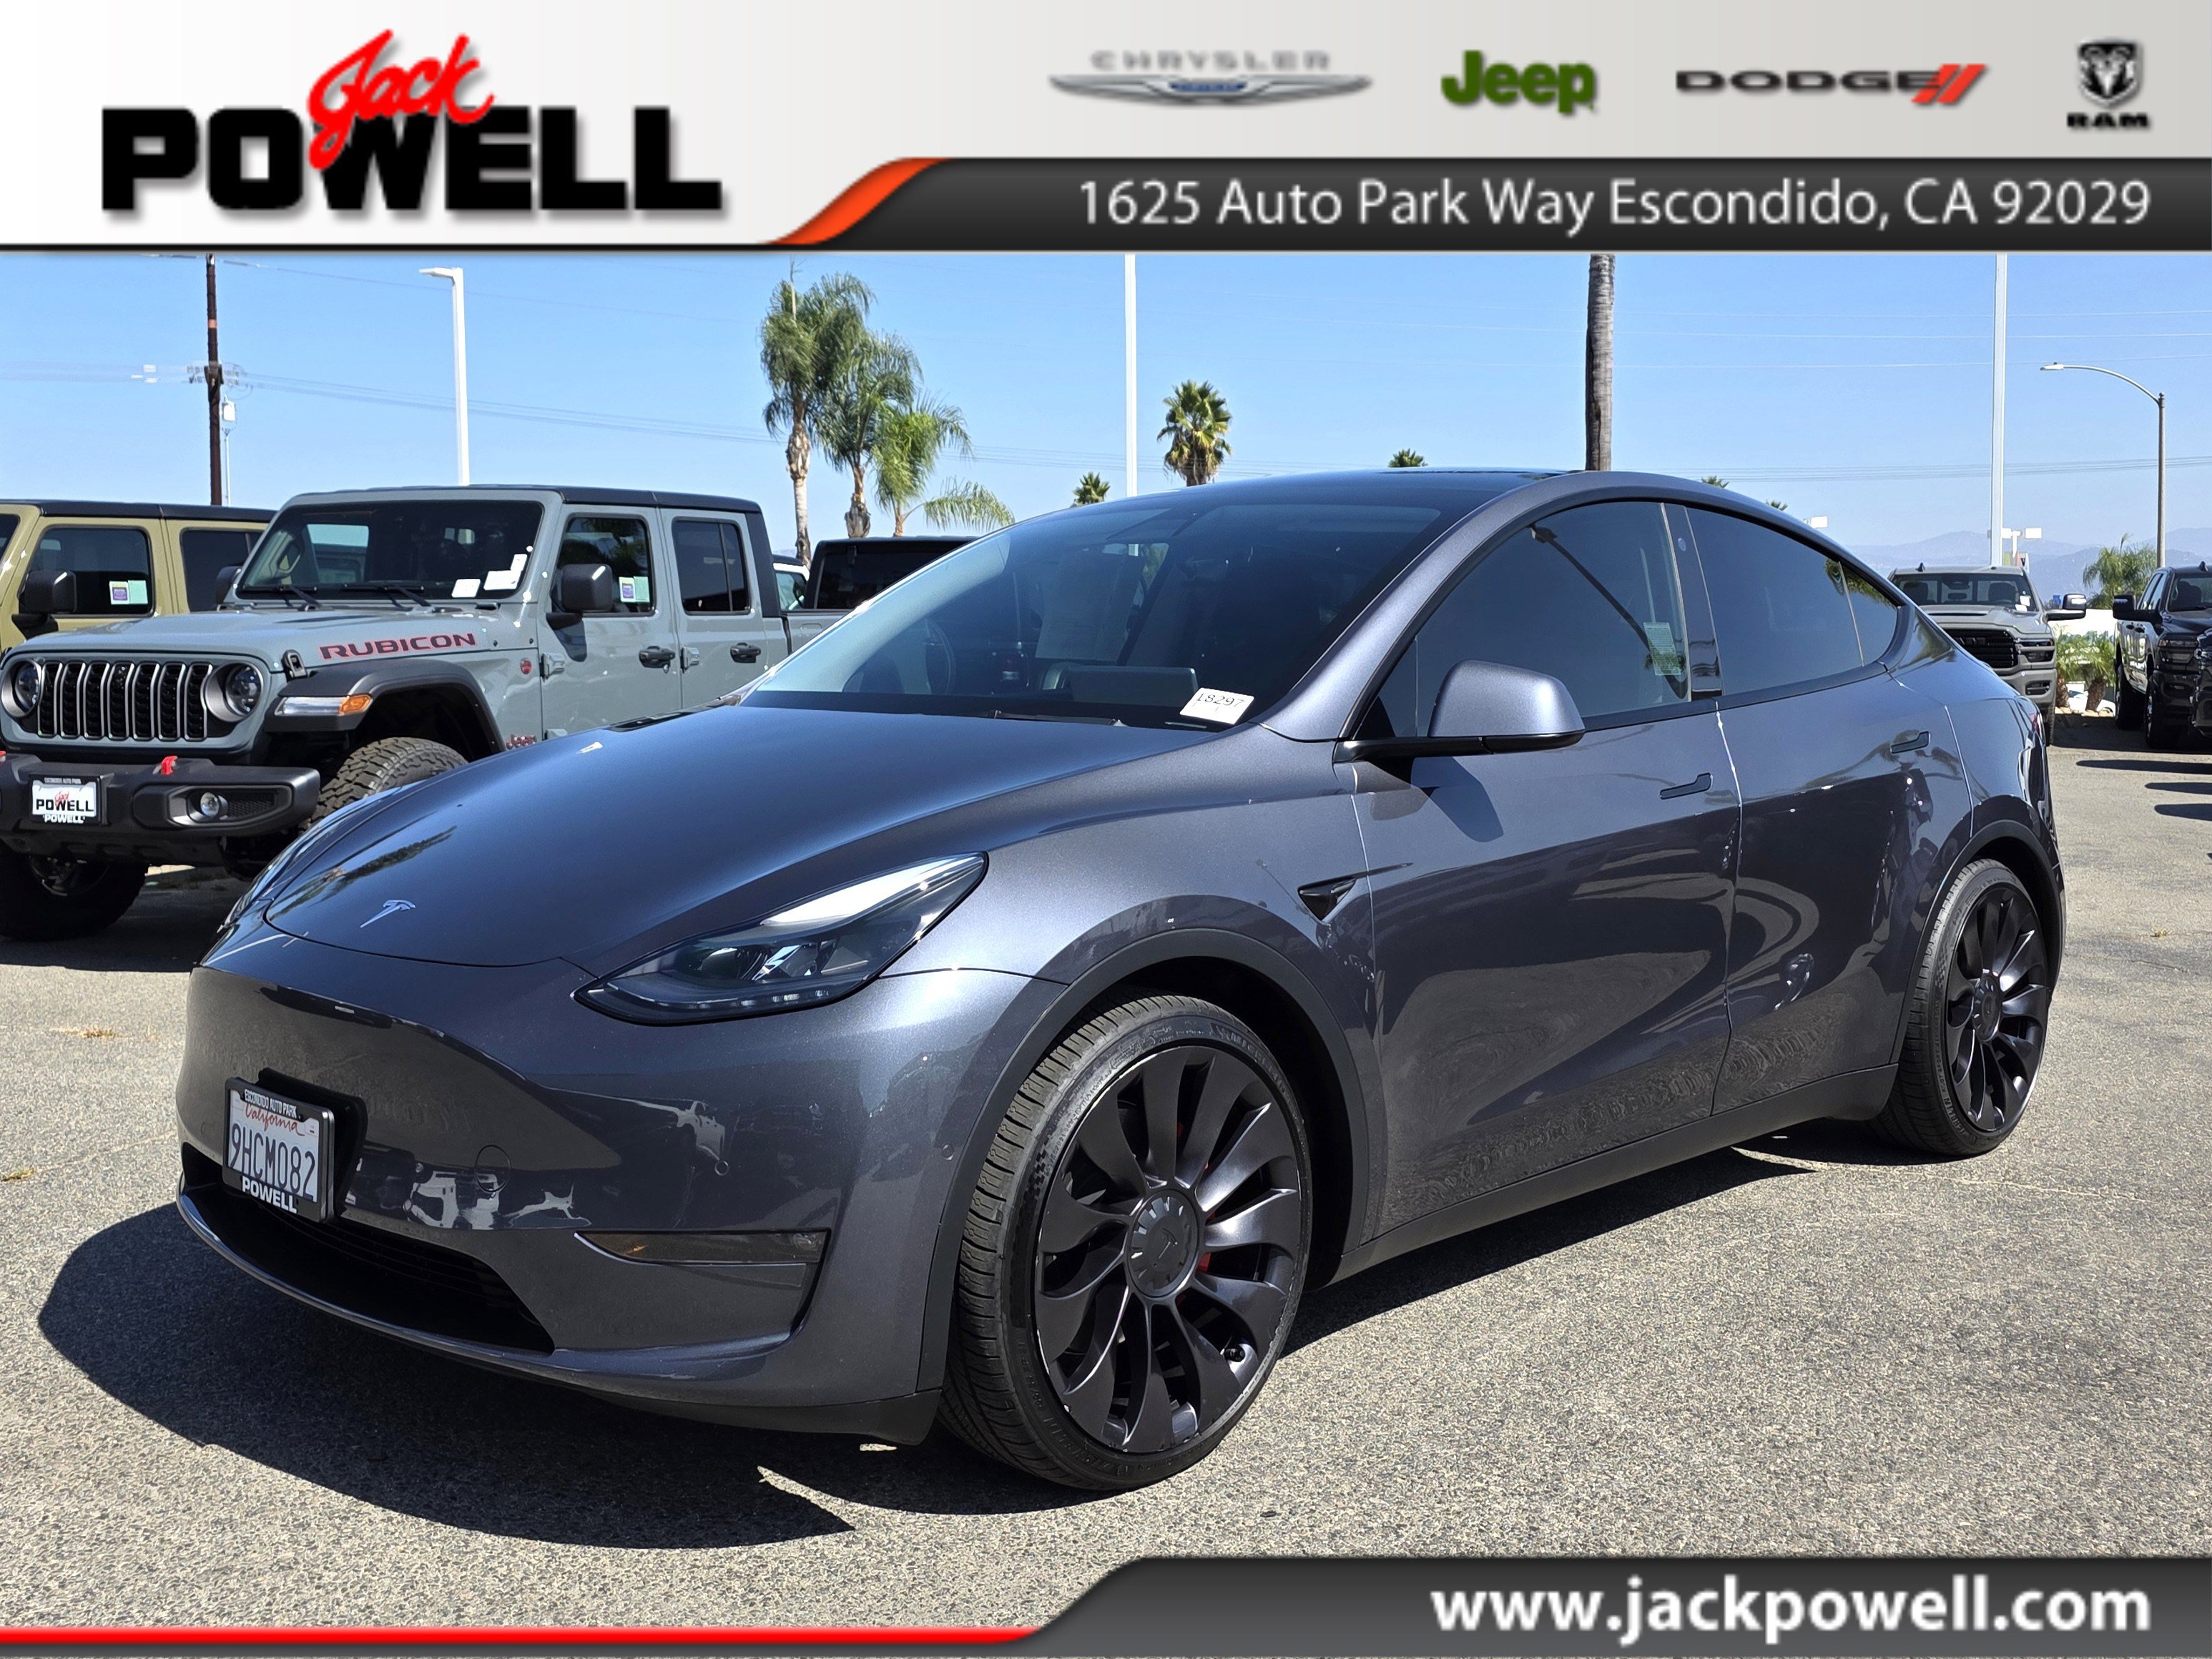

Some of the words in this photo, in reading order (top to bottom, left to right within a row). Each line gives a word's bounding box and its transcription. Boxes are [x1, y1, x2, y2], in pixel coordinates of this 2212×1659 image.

[319, 632, 477, 660] RUBICON
[1196, 692, 1246, 707] 18297
[36, 798, 94, 812] POWELL
[43, 814, 84, 824] POWELL
[244, 1103, 305, 1137] California
[269, 1098, 283, 1115] AUTO
[282, 1102, 298, 1119] PARK
[229, 1123, 315, 1201] 9HCM082
[242, 1176, 298, 1214] POWELL
